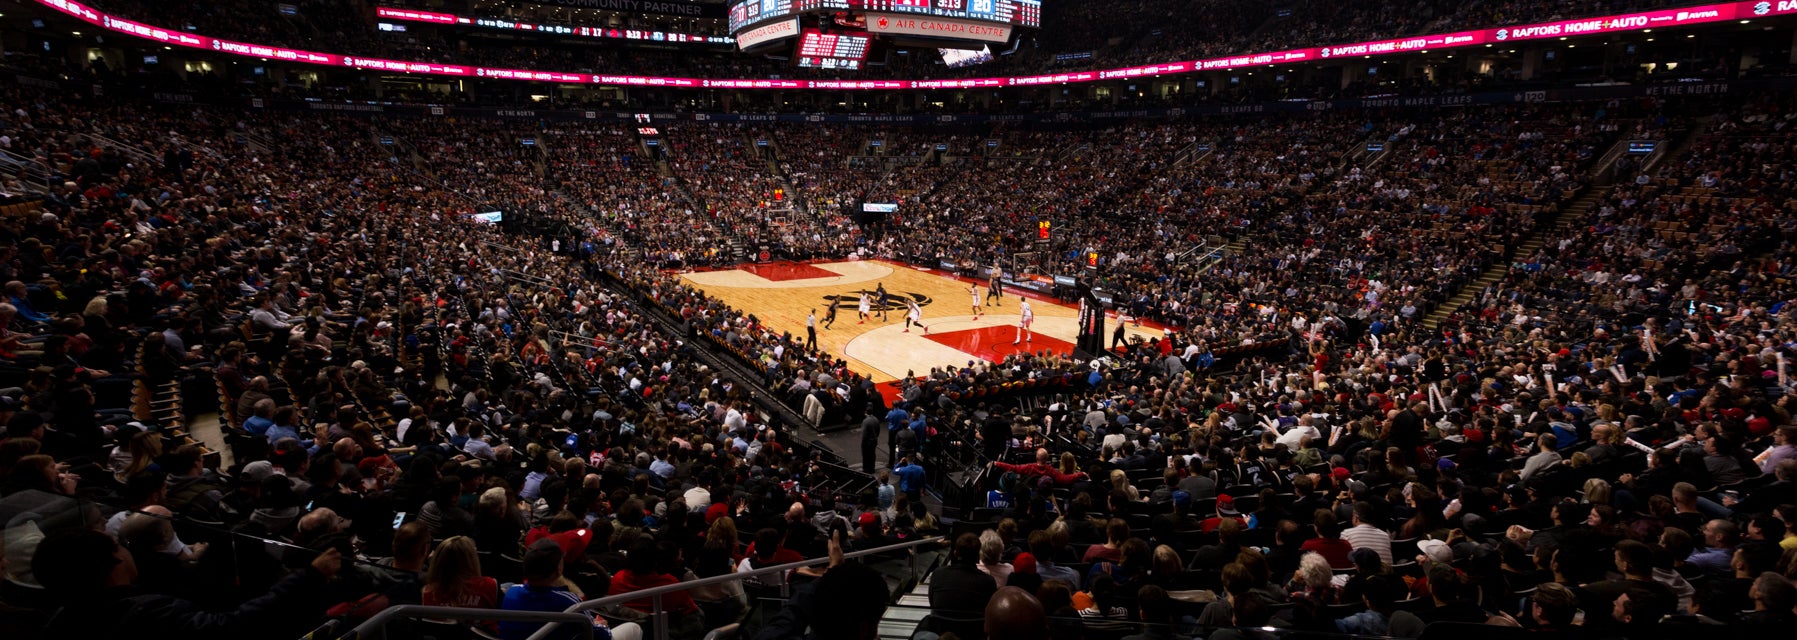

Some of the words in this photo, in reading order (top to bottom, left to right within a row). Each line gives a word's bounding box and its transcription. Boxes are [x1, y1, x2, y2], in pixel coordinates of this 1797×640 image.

[644, 2, 702, 15] PARTNER
[763, 0, 775, 12] 20
[974, 0, 991, 12] 20
[738, 7, 745, 22] 17
[896, 19, 915, 29] AIR
[921, 21, 965, 33] CANADA
[969, 24, 1004, 37] CENTRE
[1513, 25, 1561, 37] RAPTORS
[1688, 10, 1718, 19] AVIVA
[748, 28, 767, 40] CANADA
[767, 22, 792, 35] CENTRE
[222, 43, 250, 53] RAPTORS
[1333, 45, 1367, 55] RAPTORS
[355, 59, 384, 68] RAPTORS
[1204, 60, 1229, 68] RAPTORS
[1646, 86, 1658, 95] WE
[1662, 85, 1683, 95] THE
[1687, 83, 1728, 94] NORTH
[1361, 99, 1399, 107] TORONTO
[1405, 97, 1435, 106] MAPLE
[1442, 95, 1472, 105] LEAFS
[1526, 93, 1544, 101] 120
